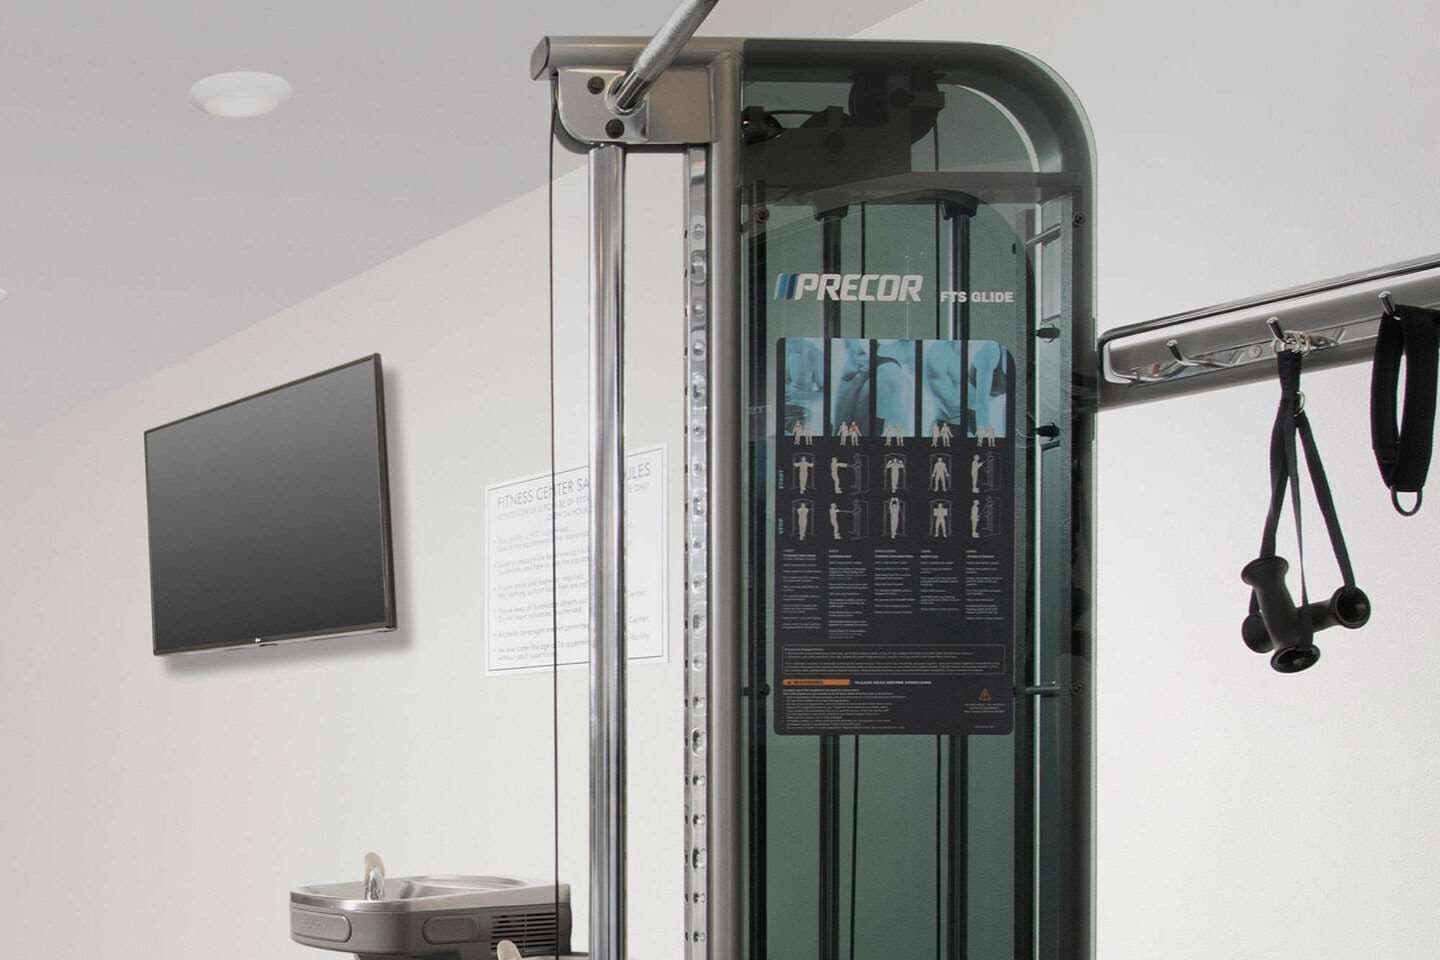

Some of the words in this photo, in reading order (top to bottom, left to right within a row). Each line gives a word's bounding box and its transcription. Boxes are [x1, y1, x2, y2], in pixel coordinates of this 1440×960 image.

[794, 272, 923, 302] PRECOR
[940, 291, 968, 303] FTS
[971, 291, 1015, 303] GLIDE
[497, 488, 534, 508] FITNESS
[625, 462, 651, 480] ULES
